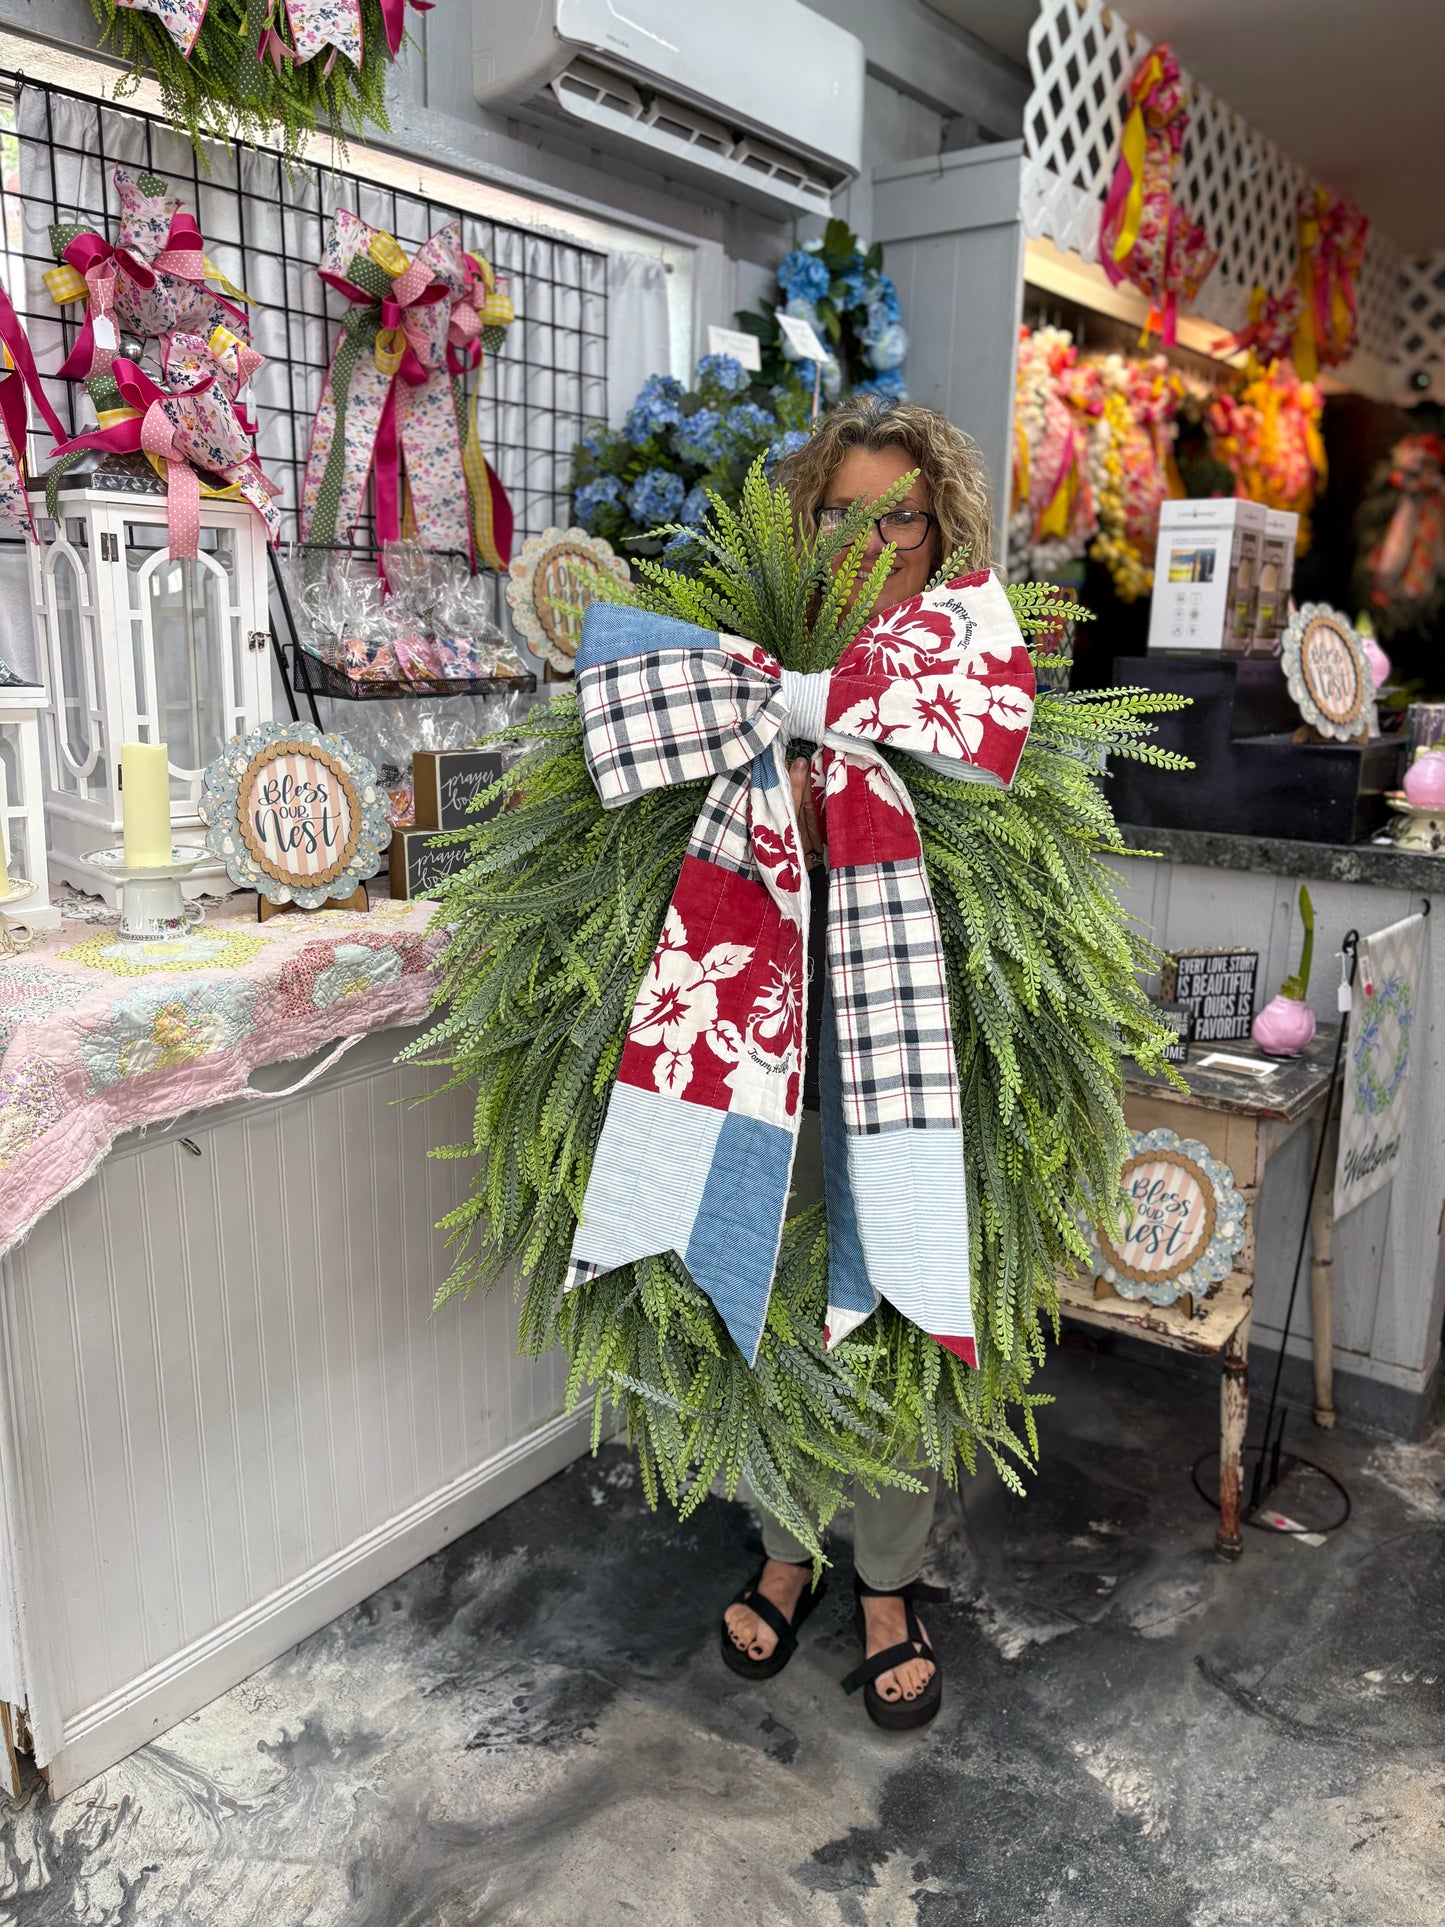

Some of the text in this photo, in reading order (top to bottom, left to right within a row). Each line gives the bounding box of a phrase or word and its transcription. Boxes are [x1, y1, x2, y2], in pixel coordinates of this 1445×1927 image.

[557, 565, 584, 589] OU
[932, 598, 978, 650] Tommy Hilfiger
[258, 774, 331, 806] Bless
[441, 769, 495, 799] prayer
[279, 805, 309, 819] OUR
[441, 788, 474, 812] bo
[255, 806, 341, 854] Nest
[409, 848, 473, 876] prayer
[410, 866, 446, 889] bo
[1179, 955, 1257, 975] EVERY LOVE STORY
[1177, 971, 1254, 998] IS BEAUTIFUL
[1203, 995, 1236, 1018] OURS
[1237, 994, 1252, 1015] IS
[1195, 1015, 1251, 1041] FAVORITE
[747, 1048, 772, 1075] Tommy
[1160, 1045, 1186, 1060] OME
[1344, 1132, 1401, 1190] Welcome
[1125, 1178, 1191, 1217] Bless
[1138, 1203, 1164, 1223] OUR
